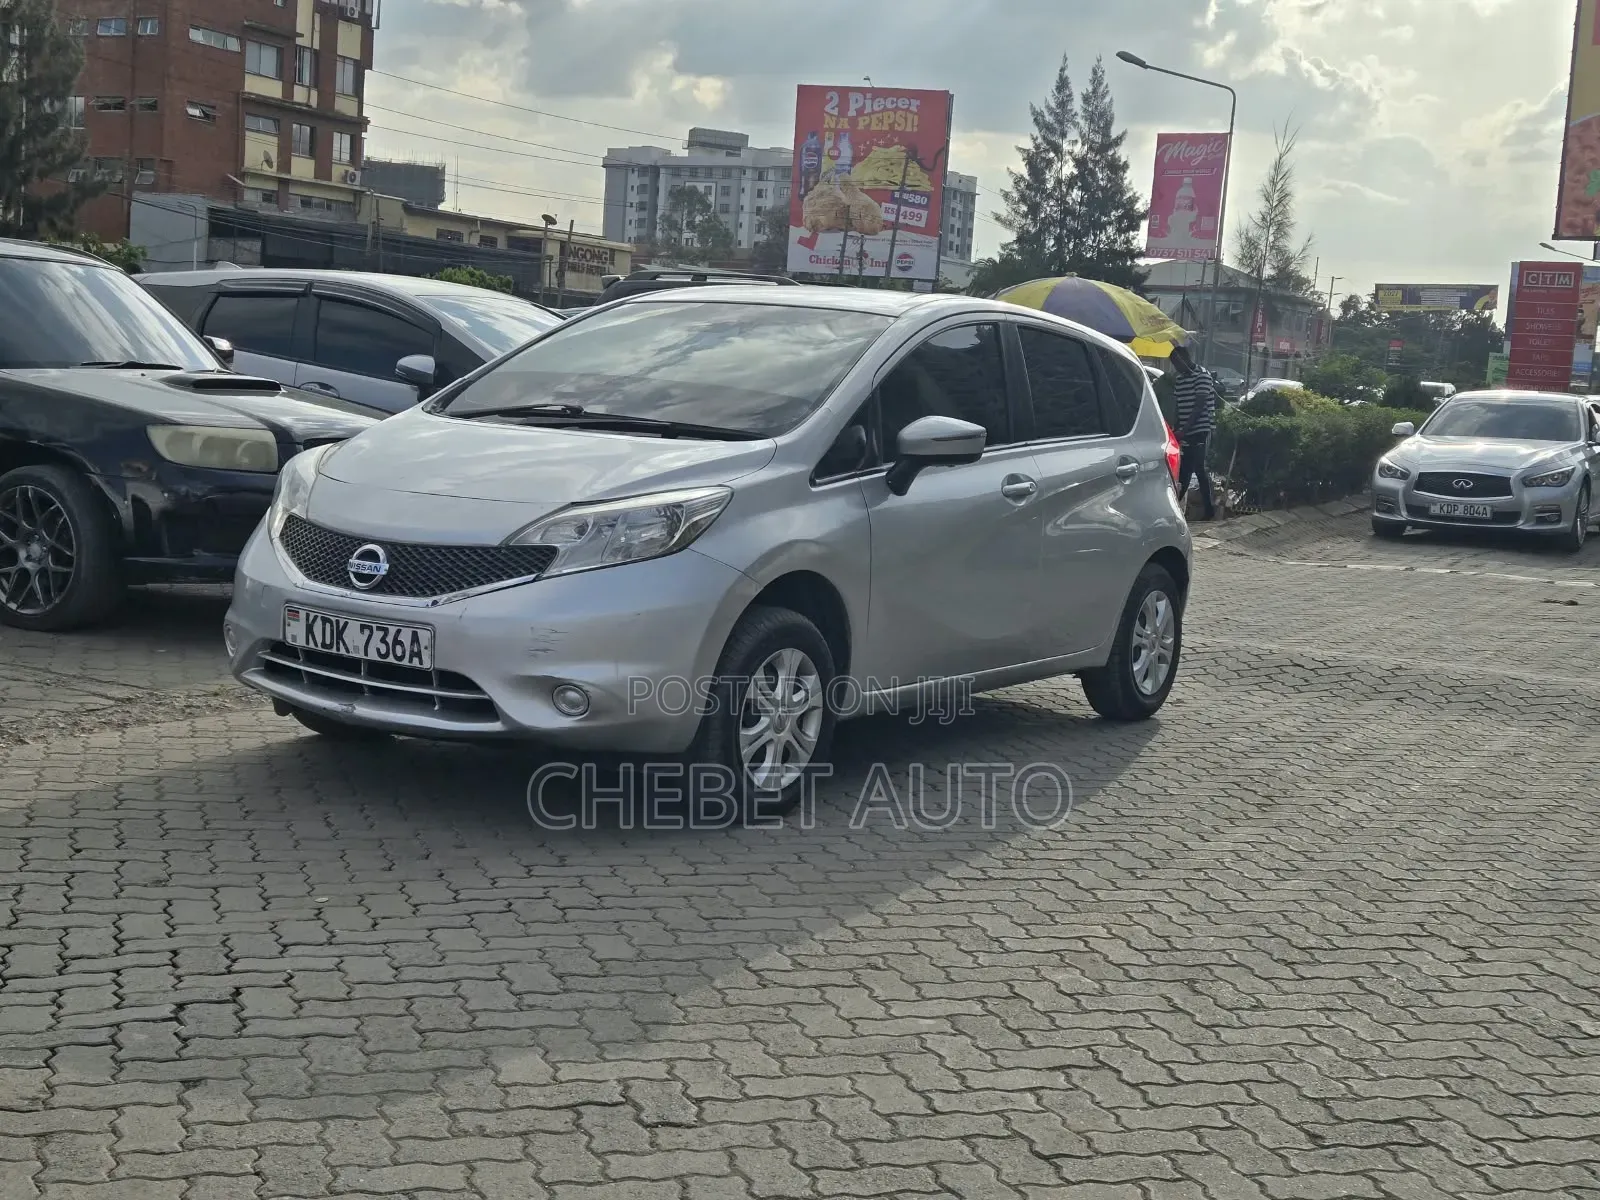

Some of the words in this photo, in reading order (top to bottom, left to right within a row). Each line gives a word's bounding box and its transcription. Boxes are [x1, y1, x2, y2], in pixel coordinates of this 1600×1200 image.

[824, 91, 839, 115] 2
[824, 113, 850, 128] NA
[857, 111, 918, 132] PEPSI!
[1157, 138, 1224, 165] Magic
[568, 246, 608, 264] NGONG
[1150, 248, 1174, 258] 0737
[1177, 249, 1192, 258] 511
[1194, 249, 1211, 258] 541
[1528, 273, 1570, 285] CTM
[1439, 503, 1459, 515] KDP
[350, 562, 382, 573] NISSAN
[305, 612, 350, 654] KDK
[359, 623, 423, 666] 736A
